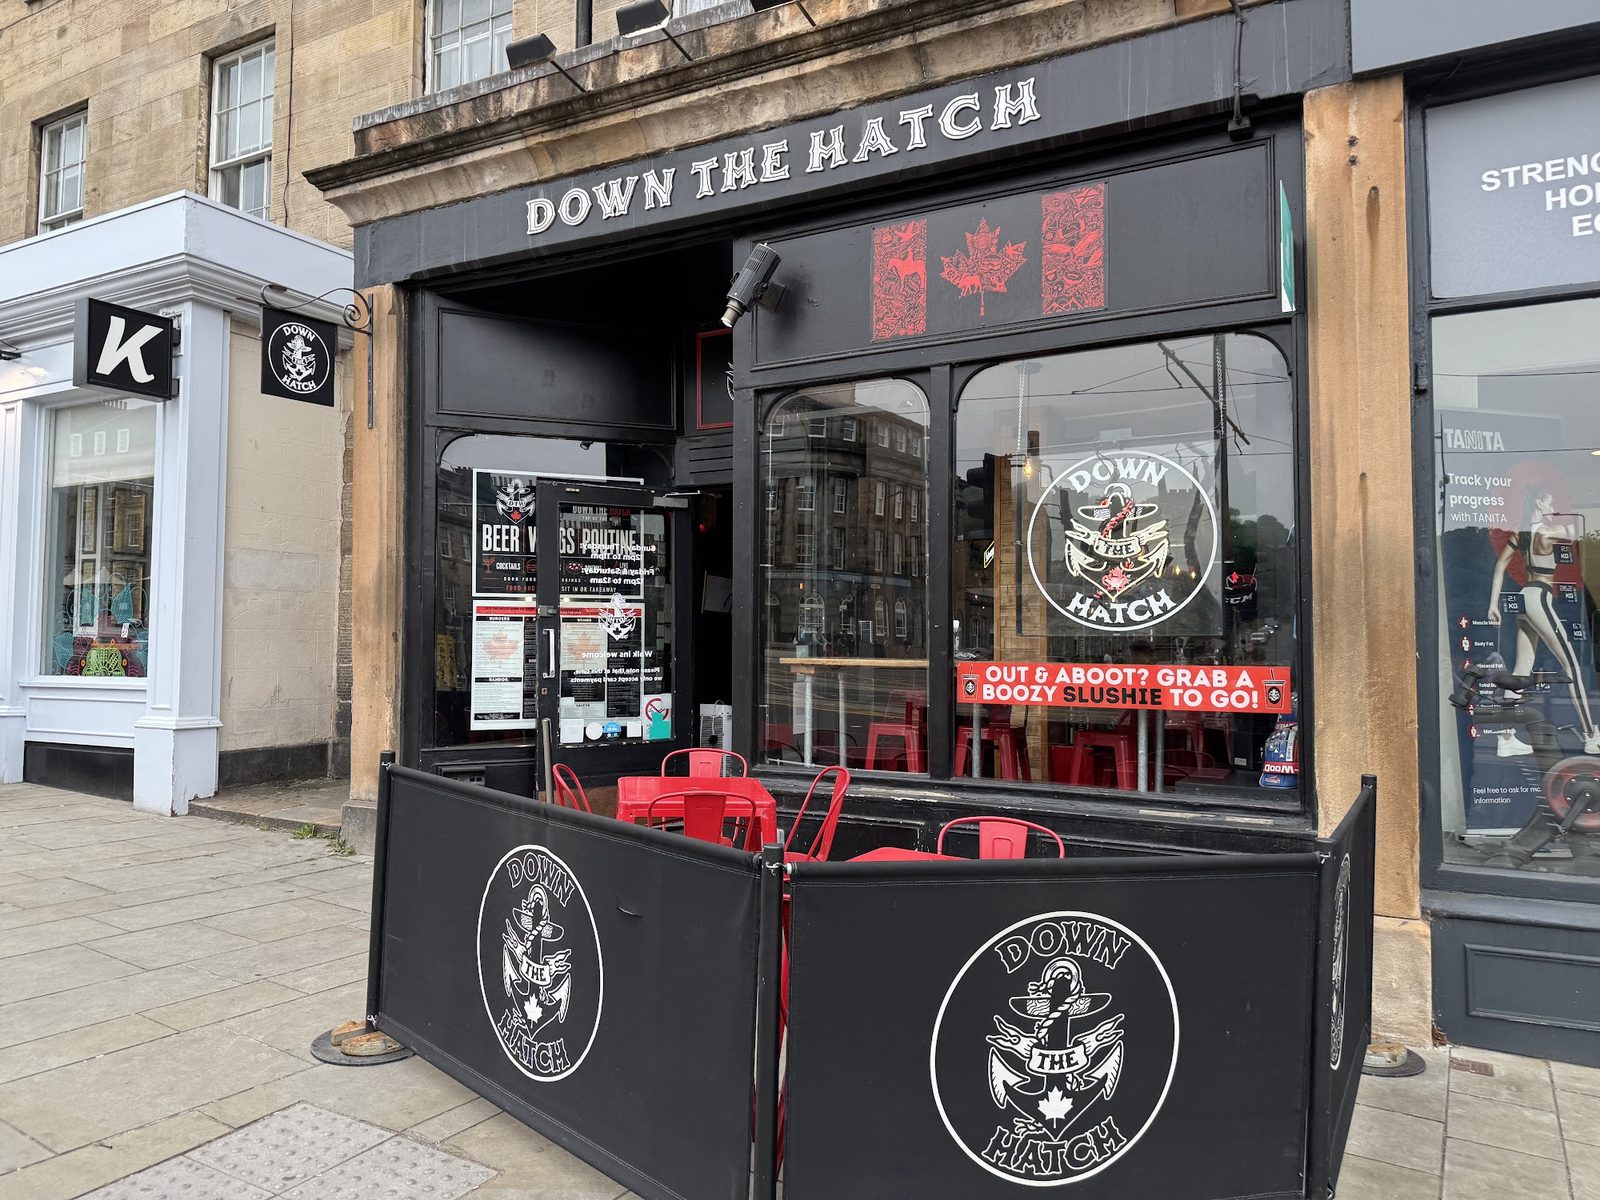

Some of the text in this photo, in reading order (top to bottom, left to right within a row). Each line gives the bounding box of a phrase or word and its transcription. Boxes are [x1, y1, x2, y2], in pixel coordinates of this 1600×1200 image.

[526, 77, 1042, 236] DOWN THE HATCH
[1545, 182, 1600, 211] HO
[282, 325, 315, 342] DOWN
[95, 315, 155, 384] K
[282, 374, 316, 391] HATCH
[1443, 428, 1505, 452] TANITA
[1066, 457, 1169, 493] DOWN
[1447, 473, 1512, 490] Track your
[1449, 494, 1505, 509] progress
[1450, 511, 1508, 523] with TANITA
[482, 524, 520, 552] BEER
[582, 529, 637, 555] POUTINE
[1103, 541, 1134, 556] THE
[496, 562, 521, 570] COCKTAILS
[1066, 588, 1177, 625] HATCH
[985, 665, 1254, 688] OUT & ABOOT? GRAB A
[982, 684, 1259, 709] BOOZY SLUSHIE TO GO!
[506, 852, 575, 907] DOWN
[994, 921, 1131, 974] DOWN
[525, 961, 547, 983] THE
[498, 1009, 571, 1074] HATCH
[1037, 1051, 1079, 1071] THE
[981, 1116, 1127, 1175] HATCH
